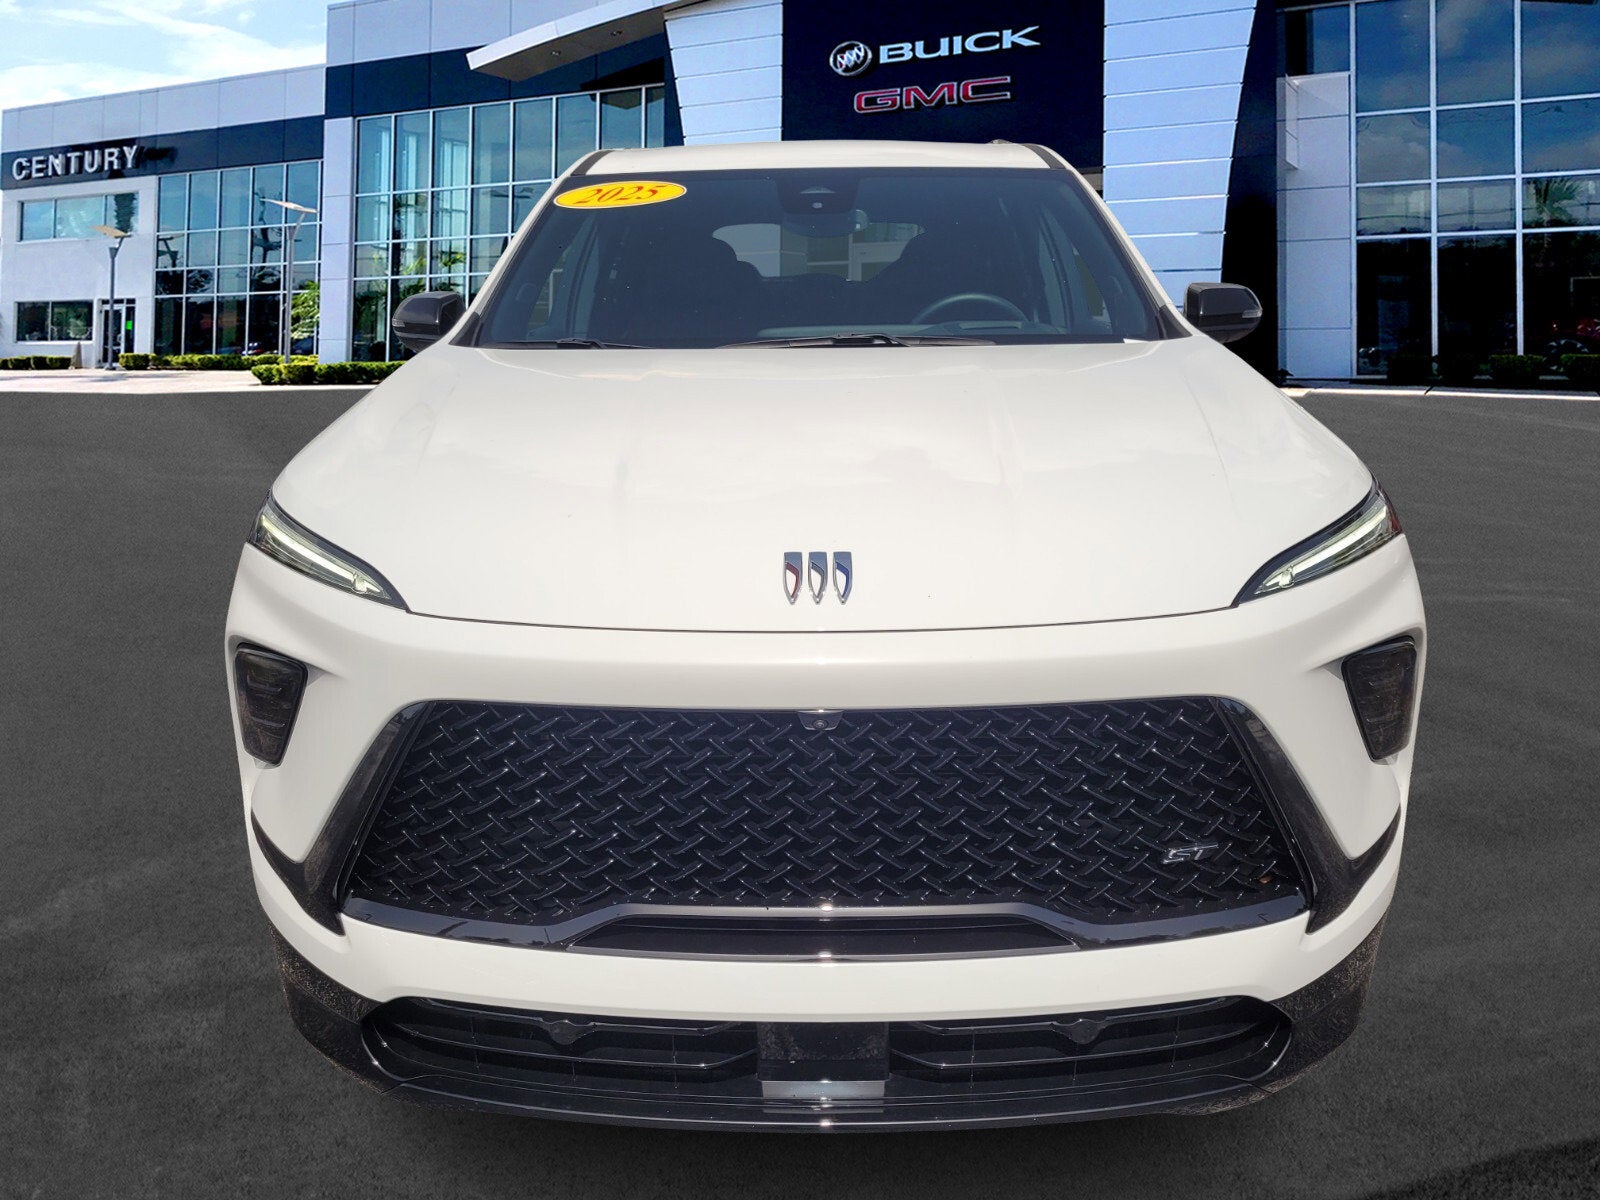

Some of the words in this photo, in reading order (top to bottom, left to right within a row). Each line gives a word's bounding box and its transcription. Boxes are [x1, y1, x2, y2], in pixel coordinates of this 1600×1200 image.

[879, 25, 1041, 64] BUICK
[854, 76, 1011, 113] GMC
[12, 145, 138, 180] CENTURY
[572, 185, 666, 205] 2025
[1162, 843, 1219, 865] ST
